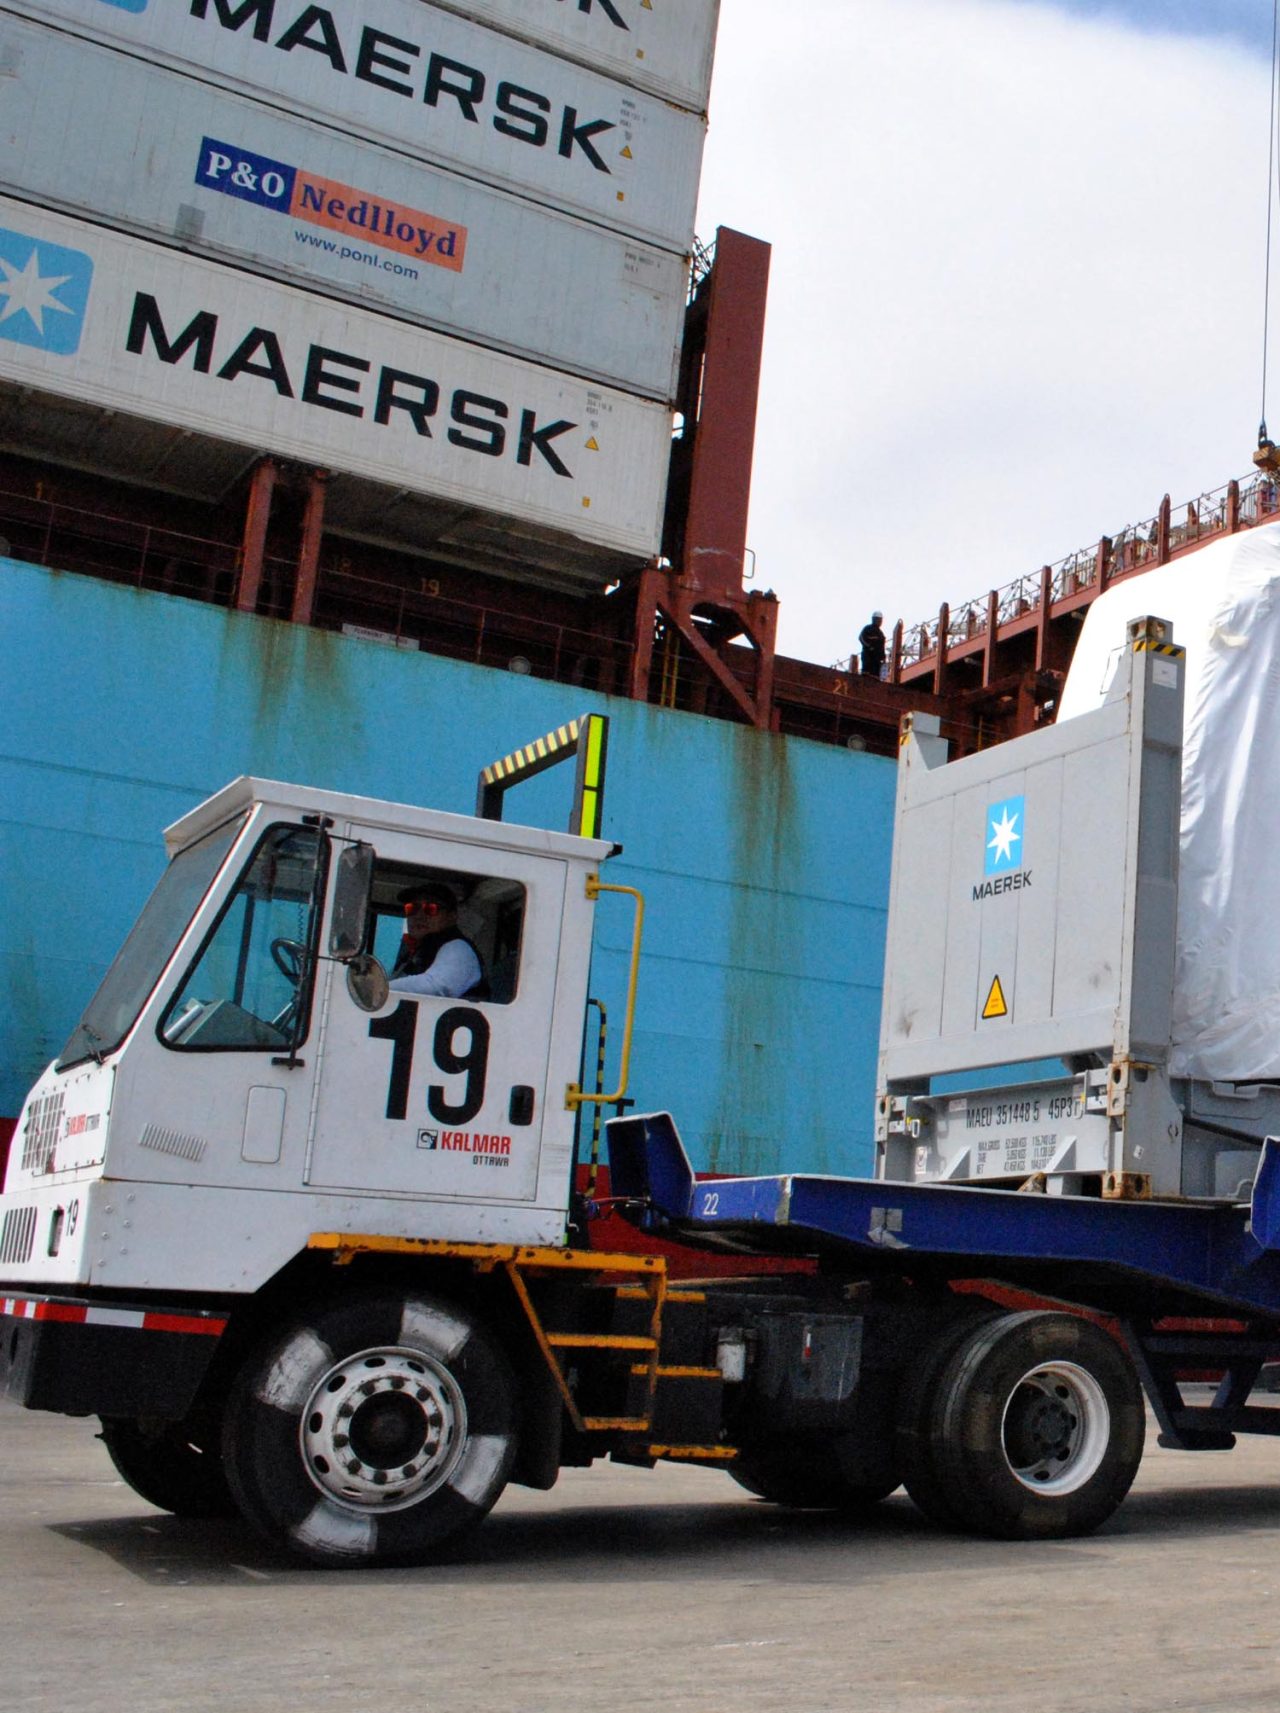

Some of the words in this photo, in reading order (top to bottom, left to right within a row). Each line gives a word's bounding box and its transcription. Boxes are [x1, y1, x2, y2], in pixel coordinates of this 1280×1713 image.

[206, 150, 286, 199] P&O
[299, 182, 458, 258] Nedlloyd
[293, 228, 419, 280] www.ponl.com
[126, 291, 578, 479] MAERSK
[973, 870, 1032, 901] MAERSK
[369, 1000, 490, 1126] 19
[966, 1107, 993, 1128] MAEU
[996, 1102, 1031, 1126] 351448
[1033, 1100, 1041, 1121] 5
[441, 1131, 511, 1155] KALMAR
[472, 1155, 509, 1167] OTTAWA
[67, 1199, 79, 1236] 19
[703, 1193, 719, 1215] 22
